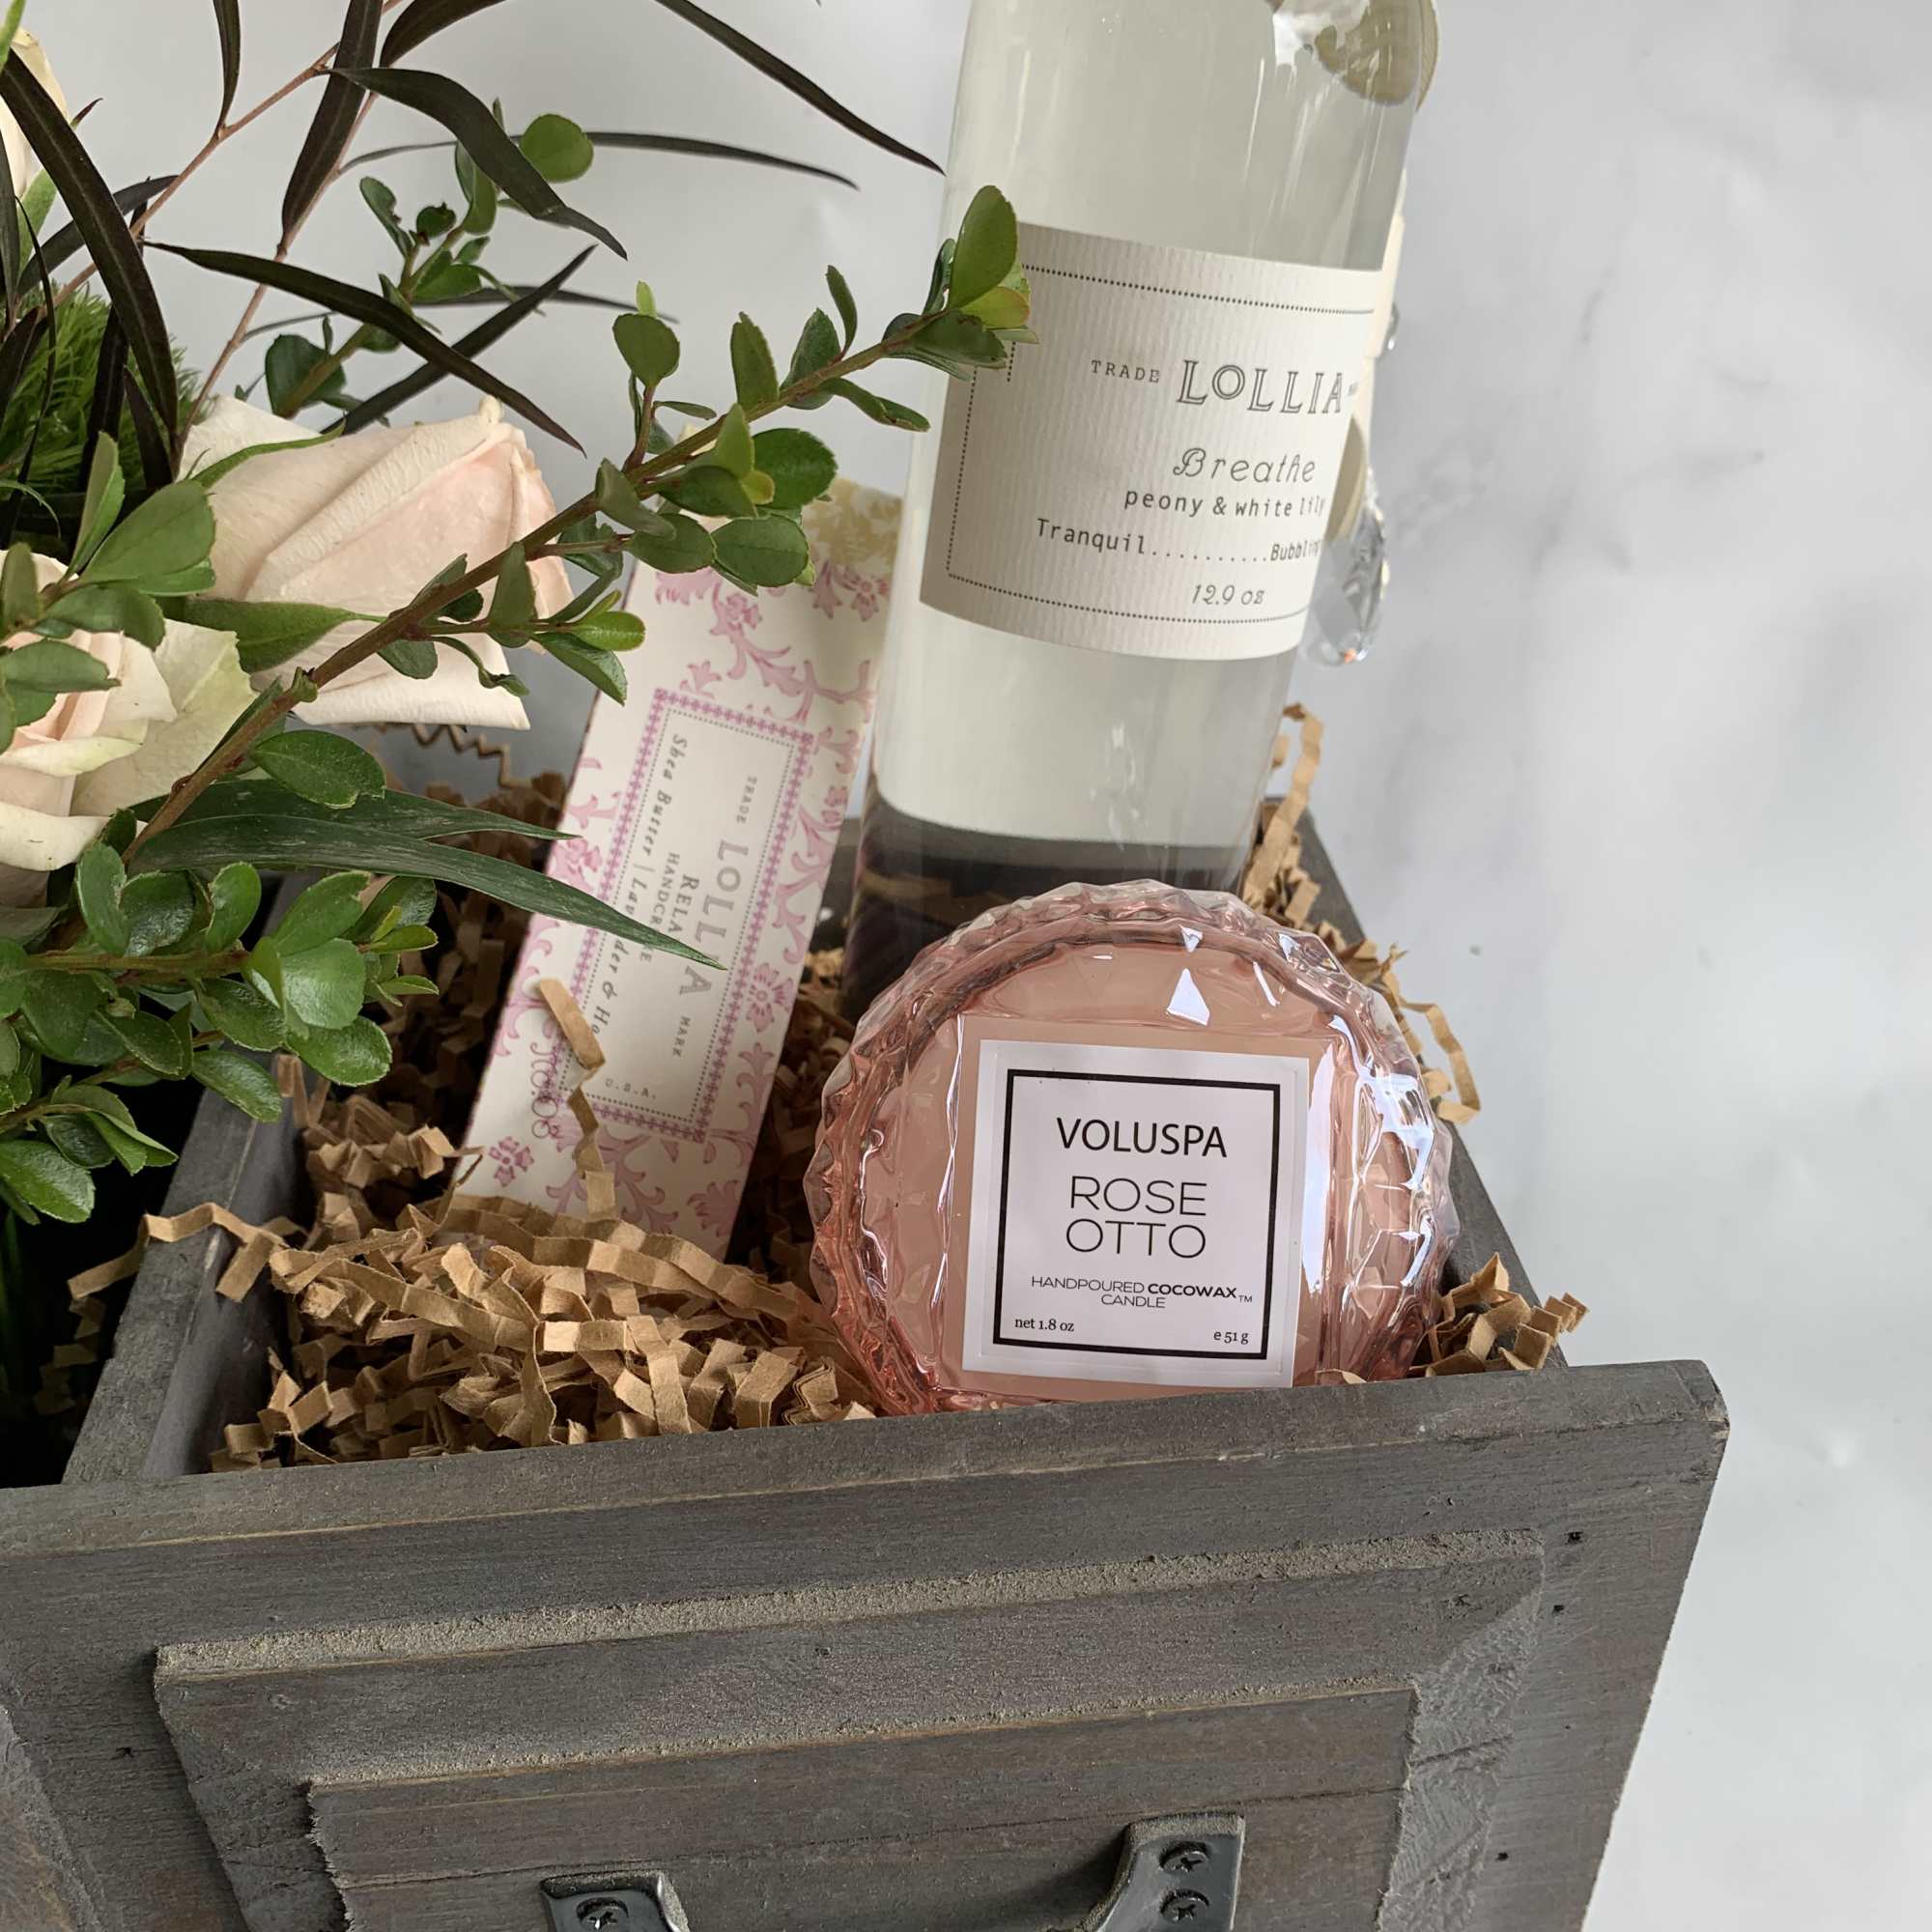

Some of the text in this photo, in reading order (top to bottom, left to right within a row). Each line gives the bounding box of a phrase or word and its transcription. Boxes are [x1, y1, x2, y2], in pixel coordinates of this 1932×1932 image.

[1092, 359, 1160, 384] TRADE
[1176, 359, 1343, 414] LOLLIA
[1173, 447, 1316, 484] Breathe
[1123, 490, 1204, 518] peony
[1212, 497, 1227, 516] &
[1236, 497, 1293, 517] white
[1191, 584, 1236, 606] 12.9
[663, 734, 688, 781] Shea
[642, 789, 672, 856] Butter
[668, 873, 700, 933] RELA
[671, 776, 758, 1059] TRADE LOLLA MARK
[611, 877, 648, 975] Lavder
[1056, 1117, 1228, 1158] VOLUSPA
[1070, 1176, 1208, 1216] ROSE
[1065, 1218, 1207, 1259] OTTO
[1031, 1275, 1145, 1293] HANDPOURED
[1101, 1293, 1165, 1309] CANDLE
[1014, 1317, 1075, 1332] net 1.8 oz
[1224, 1332, 1238, 1344] 51
[1240, 1331, 1249, 1345] g
